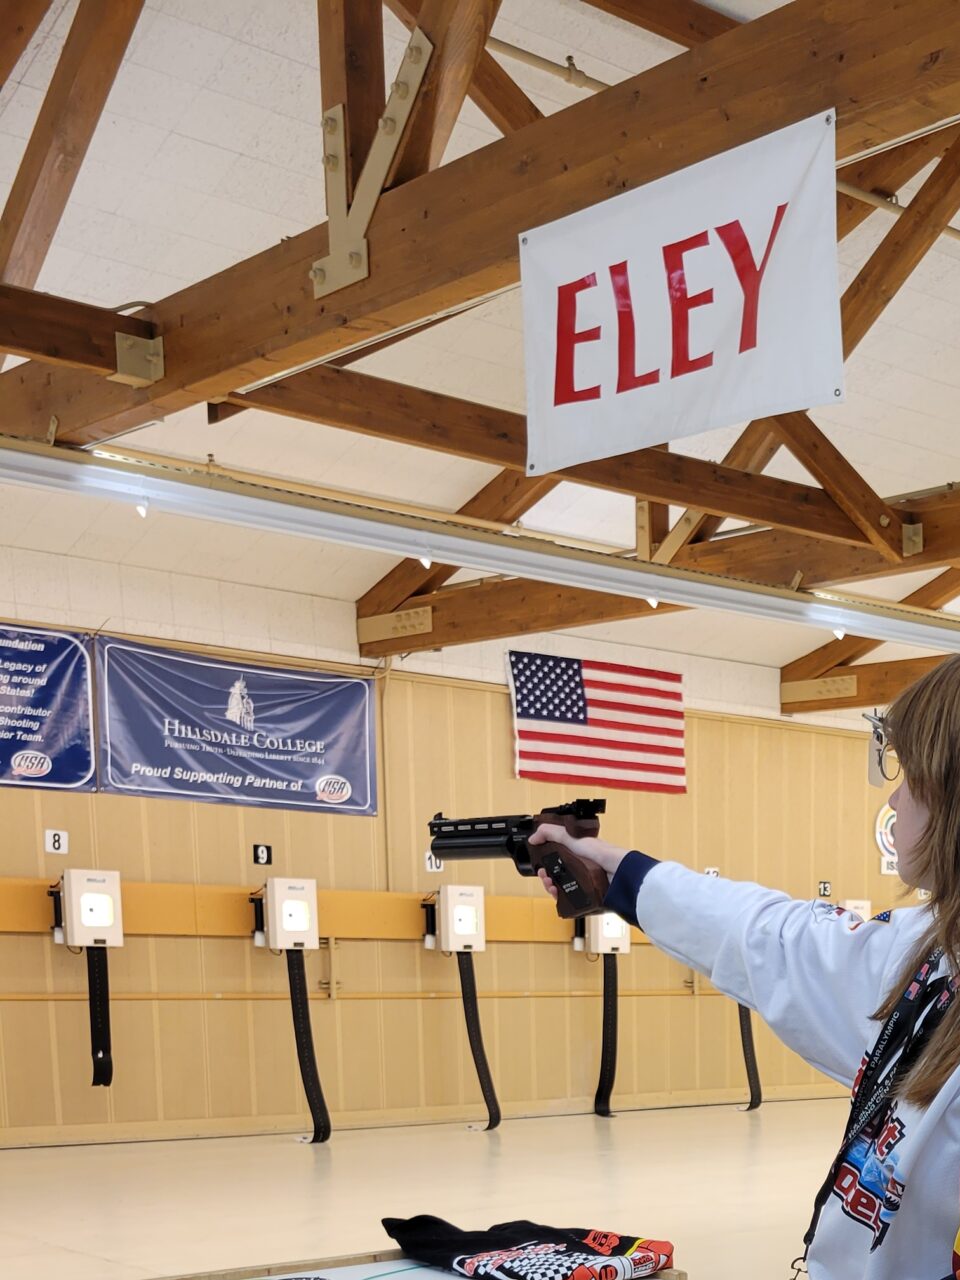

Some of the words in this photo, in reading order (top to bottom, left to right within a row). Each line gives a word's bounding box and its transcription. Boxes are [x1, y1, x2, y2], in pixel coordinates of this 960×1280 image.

[553, 201, 789, 407] ELEY
[35, 664, 47, 673] of
[11, 676, 47, 686] around
[0, 704, 52, 717] contributor
[16, 732, 45, 743] Team.
[163, 718, 250, 748] HILLSDALE
[252, 732, 326, 754] COLLEGE
[131, 763, 170, 779] Proud
[173, 766, 241, 788] Supporting
[244, 776, 289, 791] Partner
[290, 779, 303, 792] of
[52, 833, 61, 851] 8
[257, 845, 268, 864] 9
[428, 854, 442, 870] 10
[818, 882, 831, 896] 13
[870, 1010, 900, 1068] PARALYMPIC
